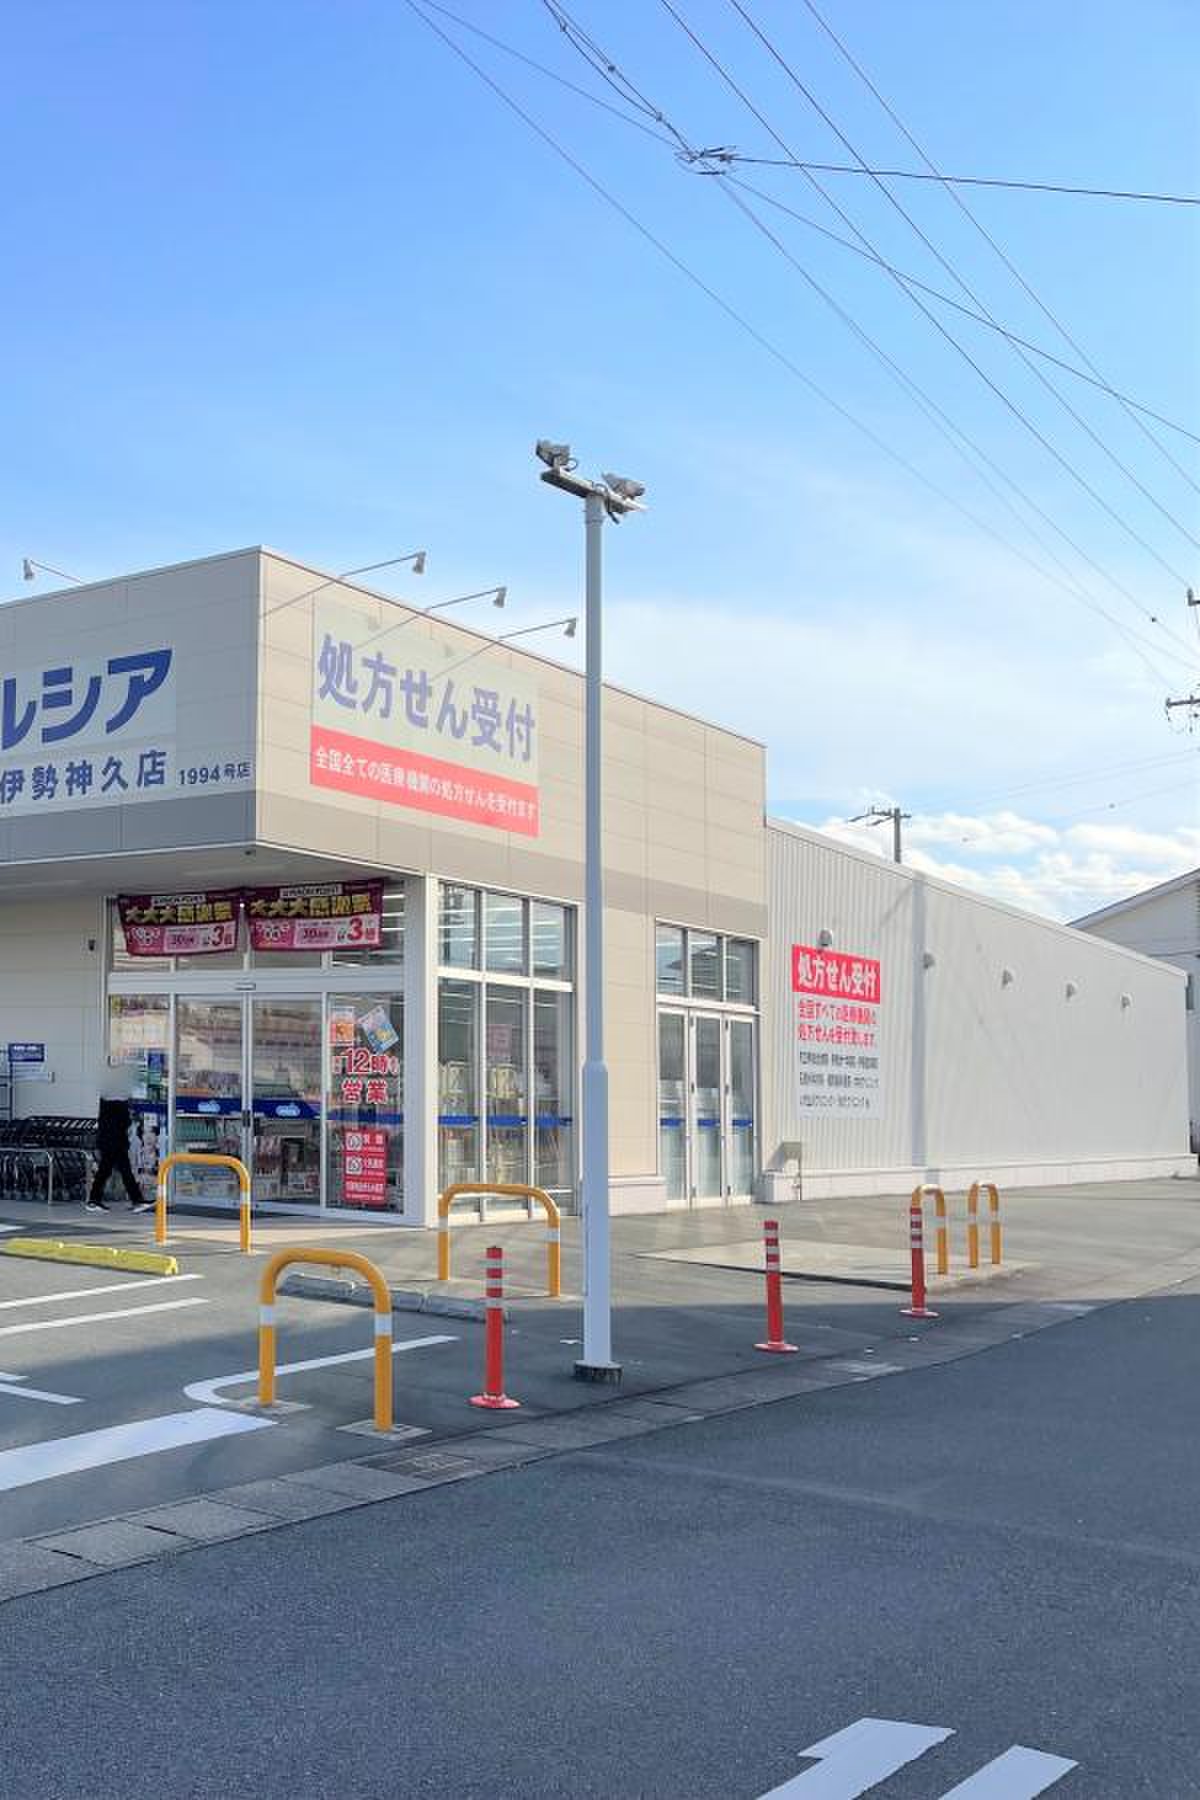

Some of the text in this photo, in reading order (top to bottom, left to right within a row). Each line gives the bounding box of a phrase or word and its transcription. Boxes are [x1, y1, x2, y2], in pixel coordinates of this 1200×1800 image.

[317, 632, 535, 763] 処方せん受付
[0, 749, 250, 803] 伊勢神久店 1994号店
[798, 951, 876, 999] 処方せん受付
[341, 1078, 388, 1105] 営業
